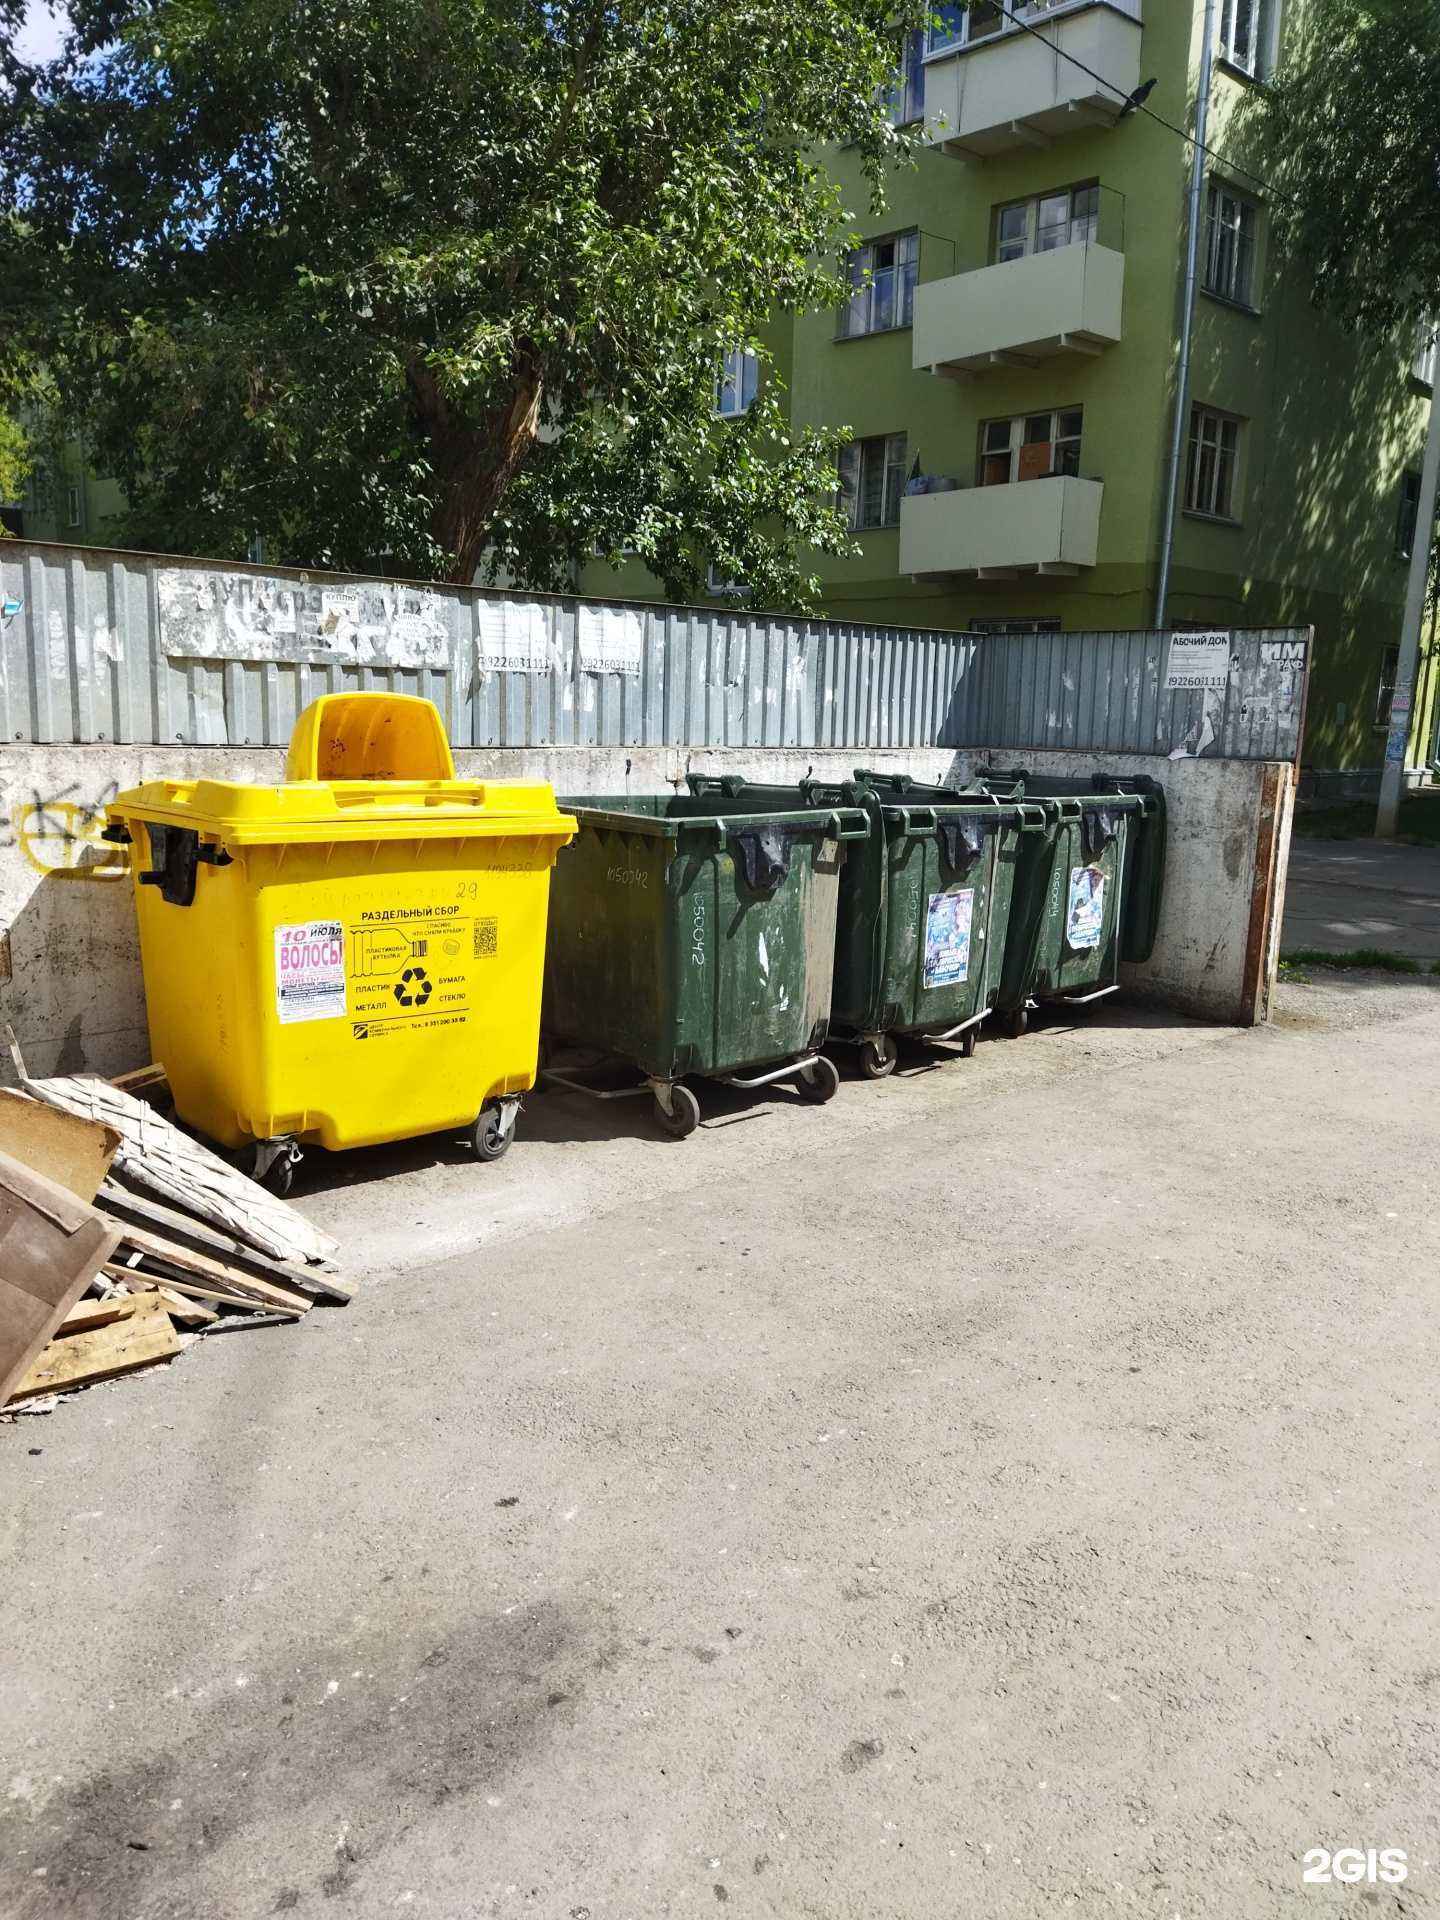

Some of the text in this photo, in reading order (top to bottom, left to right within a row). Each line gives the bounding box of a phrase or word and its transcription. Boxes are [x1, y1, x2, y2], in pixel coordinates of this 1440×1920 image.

[361, 905, 460, 921] РАЗДЕЛЬНЫЙ СБОР
[310, 926, 342, 938] ИЮЛЯ
[280, 941, 343, 970] ВОЛОСЫ
[438, 976, 466, 985] БУМАГА
[355, 984, 391, 993] ПЛАСТИК
[439, 993, 466, 1002] СТЕКЛО
[355, 1002, 387, 1012] МЕТАЛЛ
